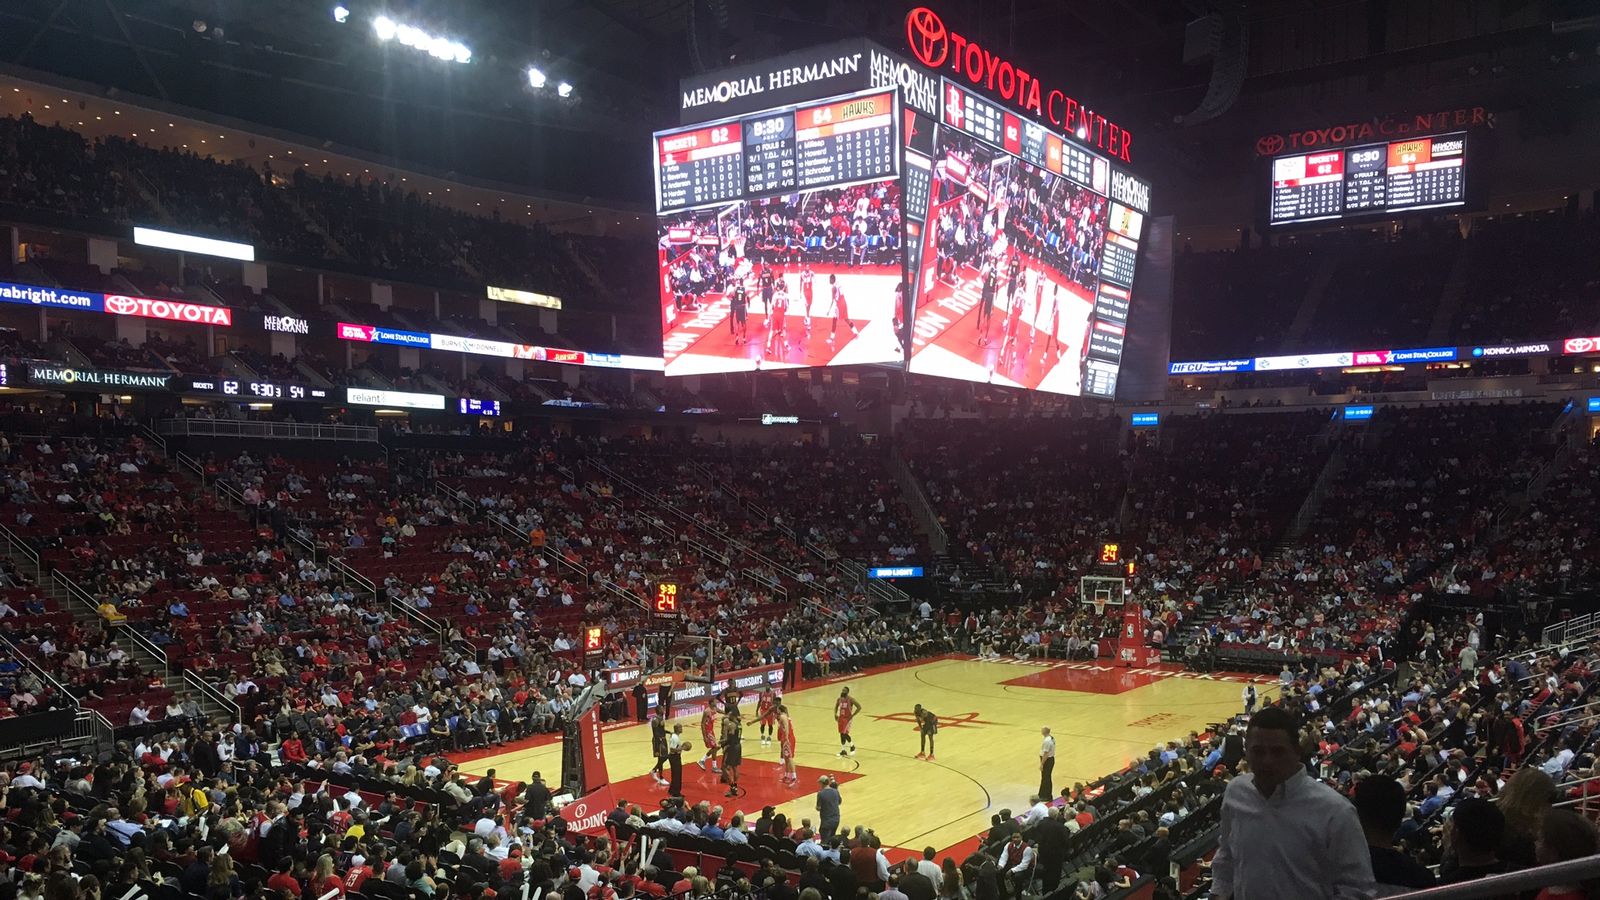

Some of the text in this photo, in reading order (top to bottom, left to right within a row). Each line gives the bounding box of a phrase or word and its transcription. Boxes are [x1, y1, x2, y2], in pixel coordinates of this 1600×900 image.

[870, 49, 937, 97] MEMORIAL
[682, 54, 862, 109] MEMORIAL HERMANN
[950, 31, 1042, 116] TOYOTA
[1046, 88, 1133, 163] CENTER
[843, 101, 875, 120] HAWKS
[711, 127, 729, 144] 62
[1289, 124, 1375, 149] TOYOTA
[762, 142, 779, 151] FOULS
[1396, 142, 1424, 155] HAWKS
[1112, 170, 1149, 195] MEMORIAL
[1112, 184, 1149, 213] HERMANN
[137, 300, 229, 326] TOYOTA
[264, 315, 309, 327] MEMORIAL
[264, 321, 309, 334] HERMANN
[407, 335, 429, 343] COLLEGE
[441, 339, 461, 348] BURNS
[1484, 344, 1550, 355] KONICA MINOLTA
[1172, 363, 1203, 372] HFCU
[34, 368, 168, 388] MEMORIAL HERMANN
[223, 381, 238, 394] 62
[250, 383, 274, 397] 9:30
[275, 387, 281, 397] 3
[290, 386, 304, 398] 54
[352, 391, 381, 404] reliant
[1103, 550, 1116, 561] 24
[660, 584, 676, 595] 9:30
[658, 594, 675, 611] 24
[619, 670, 639, 681] NBA APP
[735, 674, 763, 687] THURSDAYS
[674, 686, 705, 700] THURSDAYS
[595, 745, 600, 760] TV
